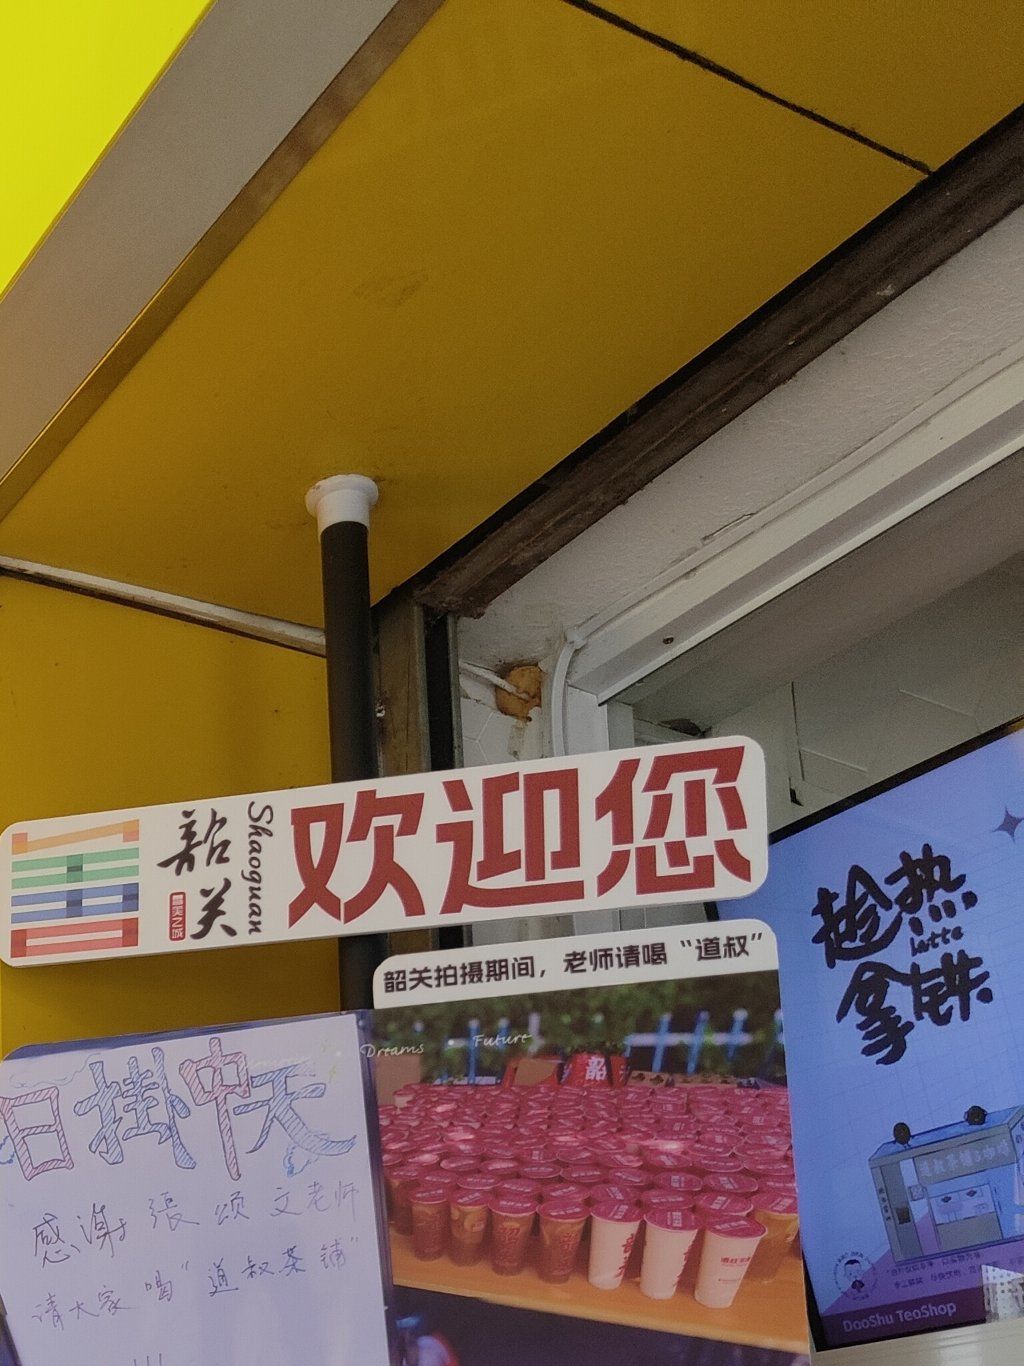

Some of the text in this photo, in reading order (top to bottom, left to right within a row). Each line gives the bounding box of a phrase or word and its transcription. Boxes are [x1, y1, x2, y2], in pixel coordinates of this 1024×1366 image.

[240, 800, 274, 935] Shaoguan
[288, 746, 752, 929] 欢迎您
